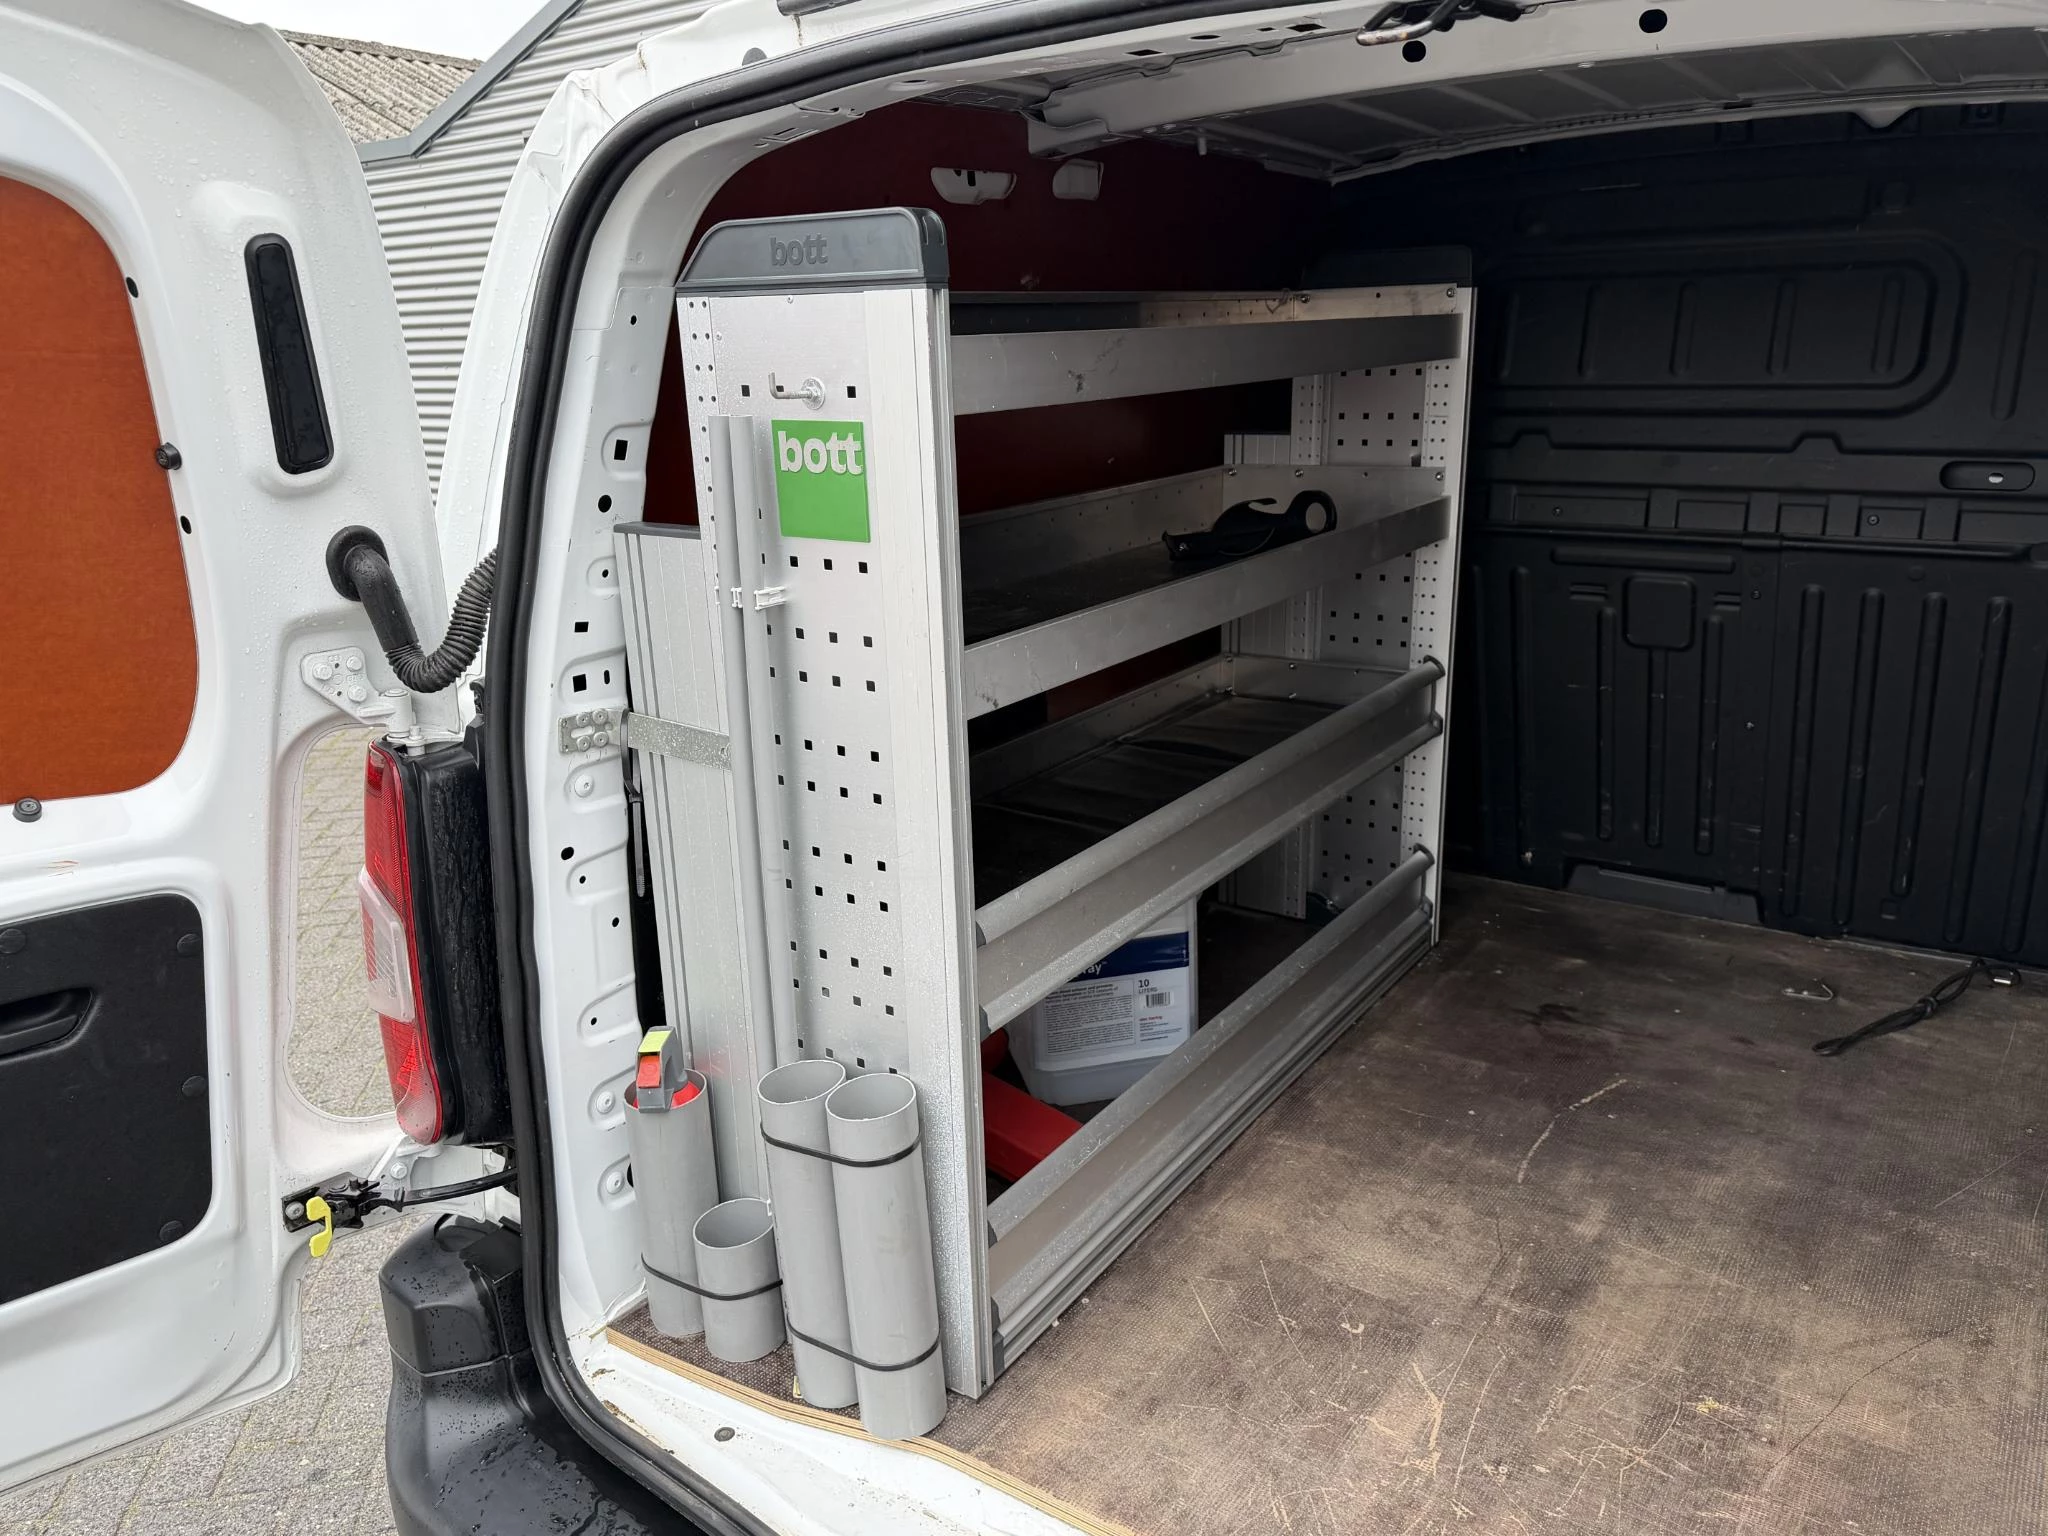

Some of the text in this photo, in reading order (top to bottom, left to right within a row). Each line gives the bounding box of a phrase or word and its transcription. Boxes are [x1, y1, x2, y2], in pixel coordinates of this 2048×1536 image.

[770, 233, 828, 265] bott
[778, 431, 863, 475] bott
[1138, 979, 1150, 988] 10
